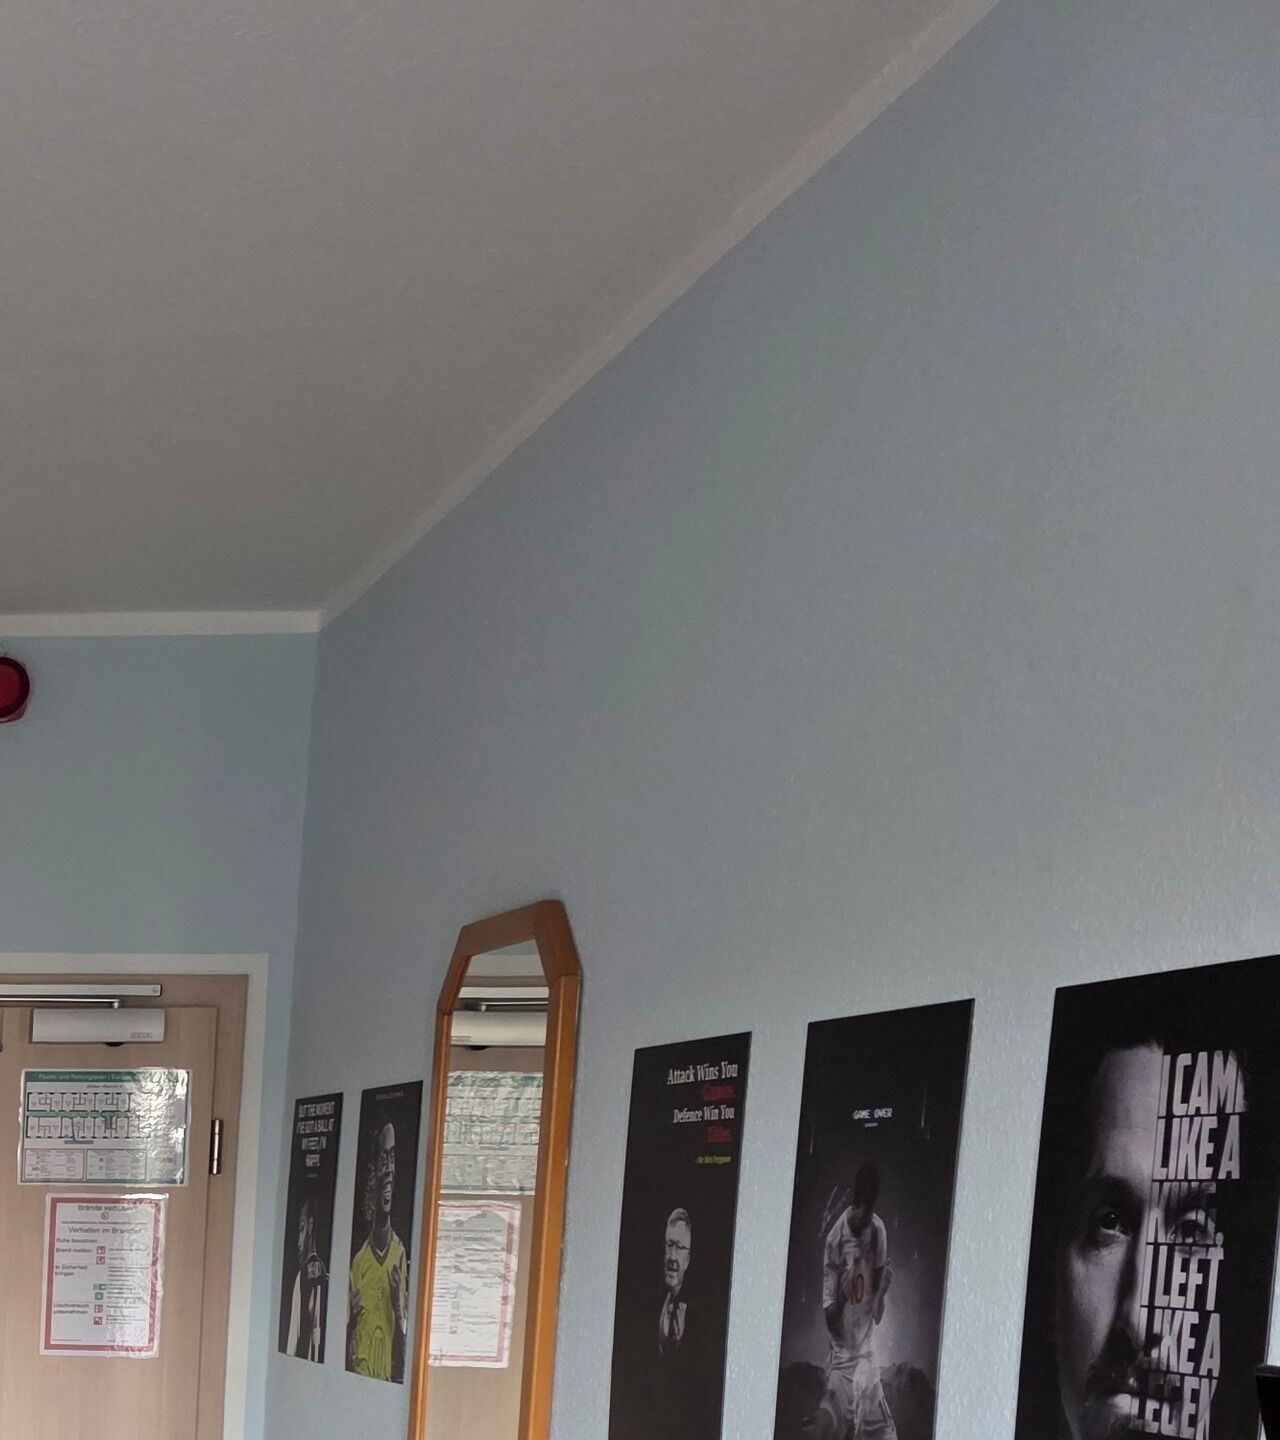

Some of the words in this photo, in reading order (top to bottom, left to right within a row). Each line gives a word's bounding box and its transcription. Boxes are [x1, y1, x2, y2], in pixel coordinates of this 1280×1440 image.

[666, 1064, 695, 1085] Attack
[696, 1063, 719, 1081] Wins
[720, 1061, 738, 1079] You
[1158, 1054, 1172, 1117] I
[673, 1107, 703, 1123] Defence
[703, 1105, 719, 1120] Win
[720, 1104, 735, 1119] You
[853, 1109, 871, 1120] GAME
[874, 1107, 893, 1118] OVER
[1154, 1116, 1218, 1180] LIKE
[1218, 1114, 1240, 1180] A
[1142, 1244, 1154, 1306] I
[1154, 1245, 1224, 1312] LEFT
[1139, 1307, 1200, 1373] LIKE
[1199, 1313, 1221, 1378] A
